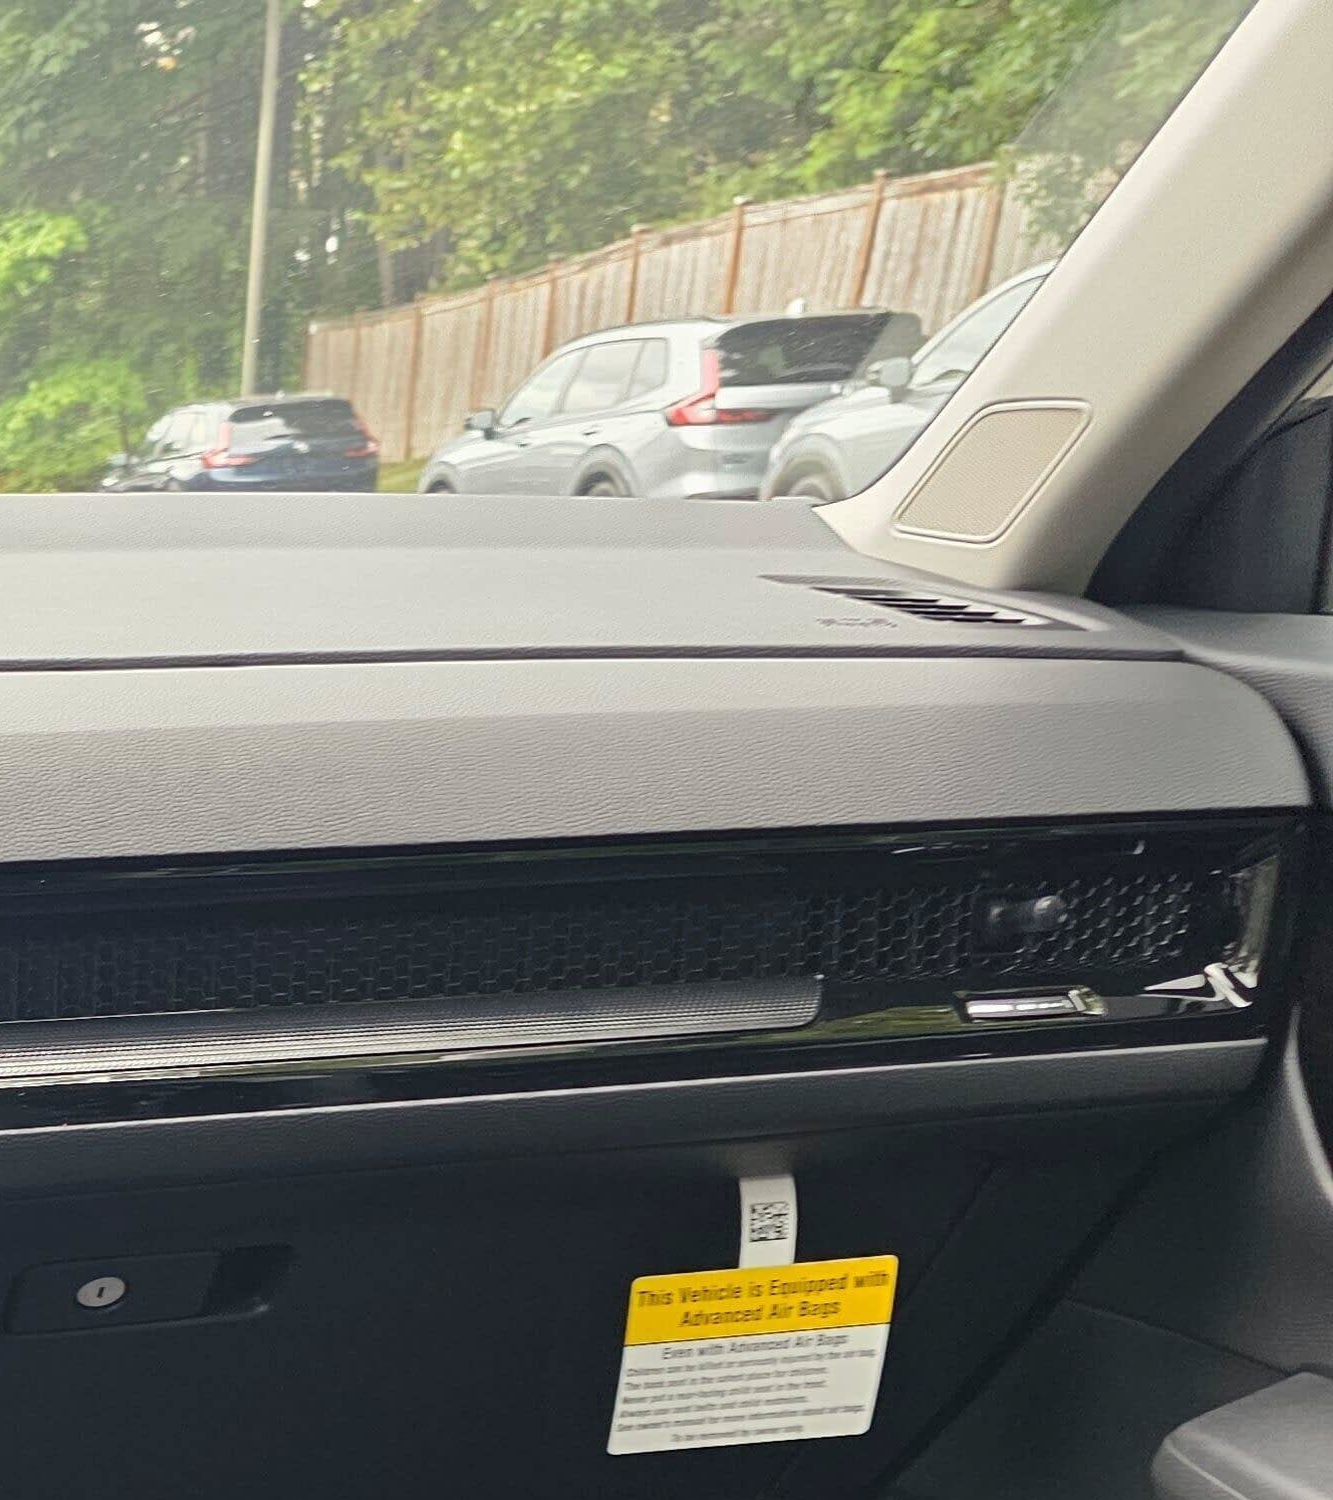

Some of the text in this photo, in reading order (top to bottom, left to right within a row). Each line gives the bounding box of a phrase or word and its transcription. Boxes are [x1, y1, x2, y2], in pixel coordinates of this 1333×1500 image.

[637, 1271, 890, 1307] This Vehicle is Equipped with
[677, 1300, 841, 1328] Advanced Air Bags
[729, 1337, 790, 1354] Advanced
